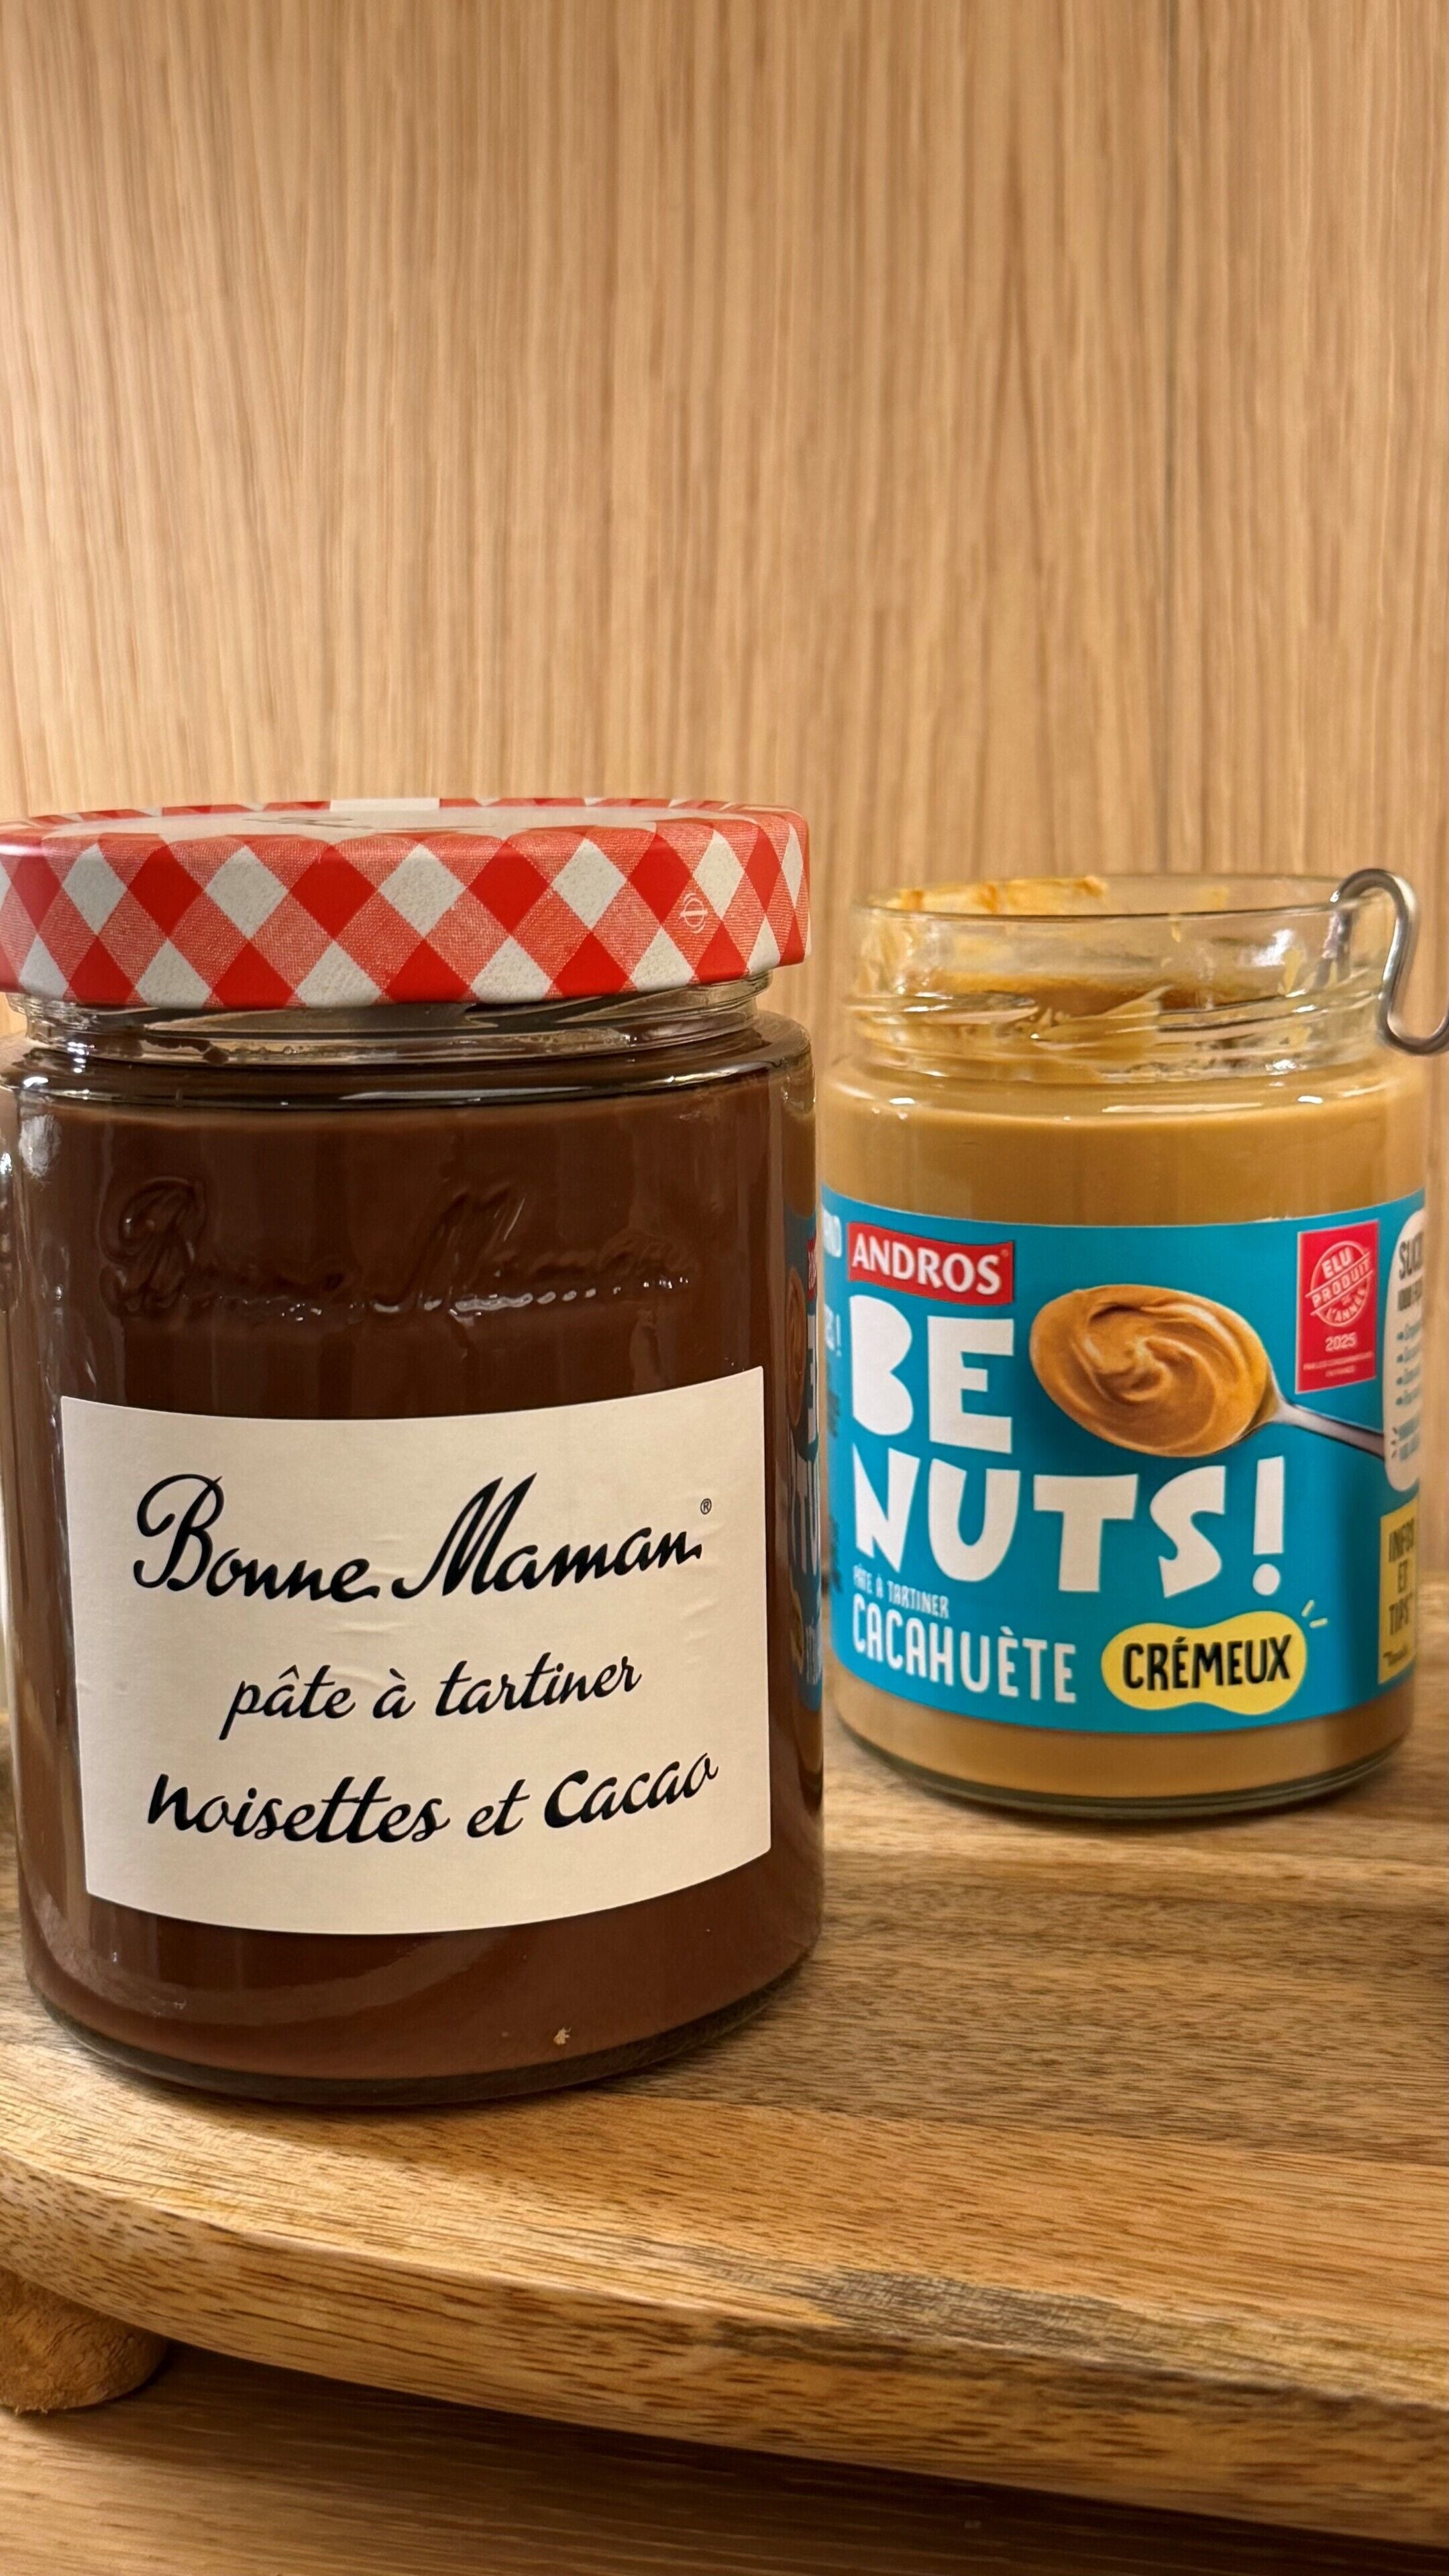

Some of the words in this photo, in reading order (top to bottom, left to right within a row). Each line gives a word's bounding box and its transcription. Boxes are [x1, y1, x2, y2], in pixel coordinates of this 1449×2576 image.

[853, 1233, 1001, 1295] ANDROS
[1311, 1256, 1371, 1308] PRODUIT
[1325, 1331, 1357, 1352] 2025
[850, 1295, 1014, 1454] BE
[133, 1474, 380, 1603] Bonne
[853, 1442, 1285, 1598] NUTS!
[886, 1580, 949, 1619] TARTINER
[853, 1593, 1077, 1703] CACAHUÈTE
[1123, 1634, 1291, 1690] CRÉMEUX
[219, 1664, 356, 1741] pâte
[372, 1668, 416, 1719] à
[435, 1652, 642, 1717] tartiner
[467, 1779, 530, 1838] et
